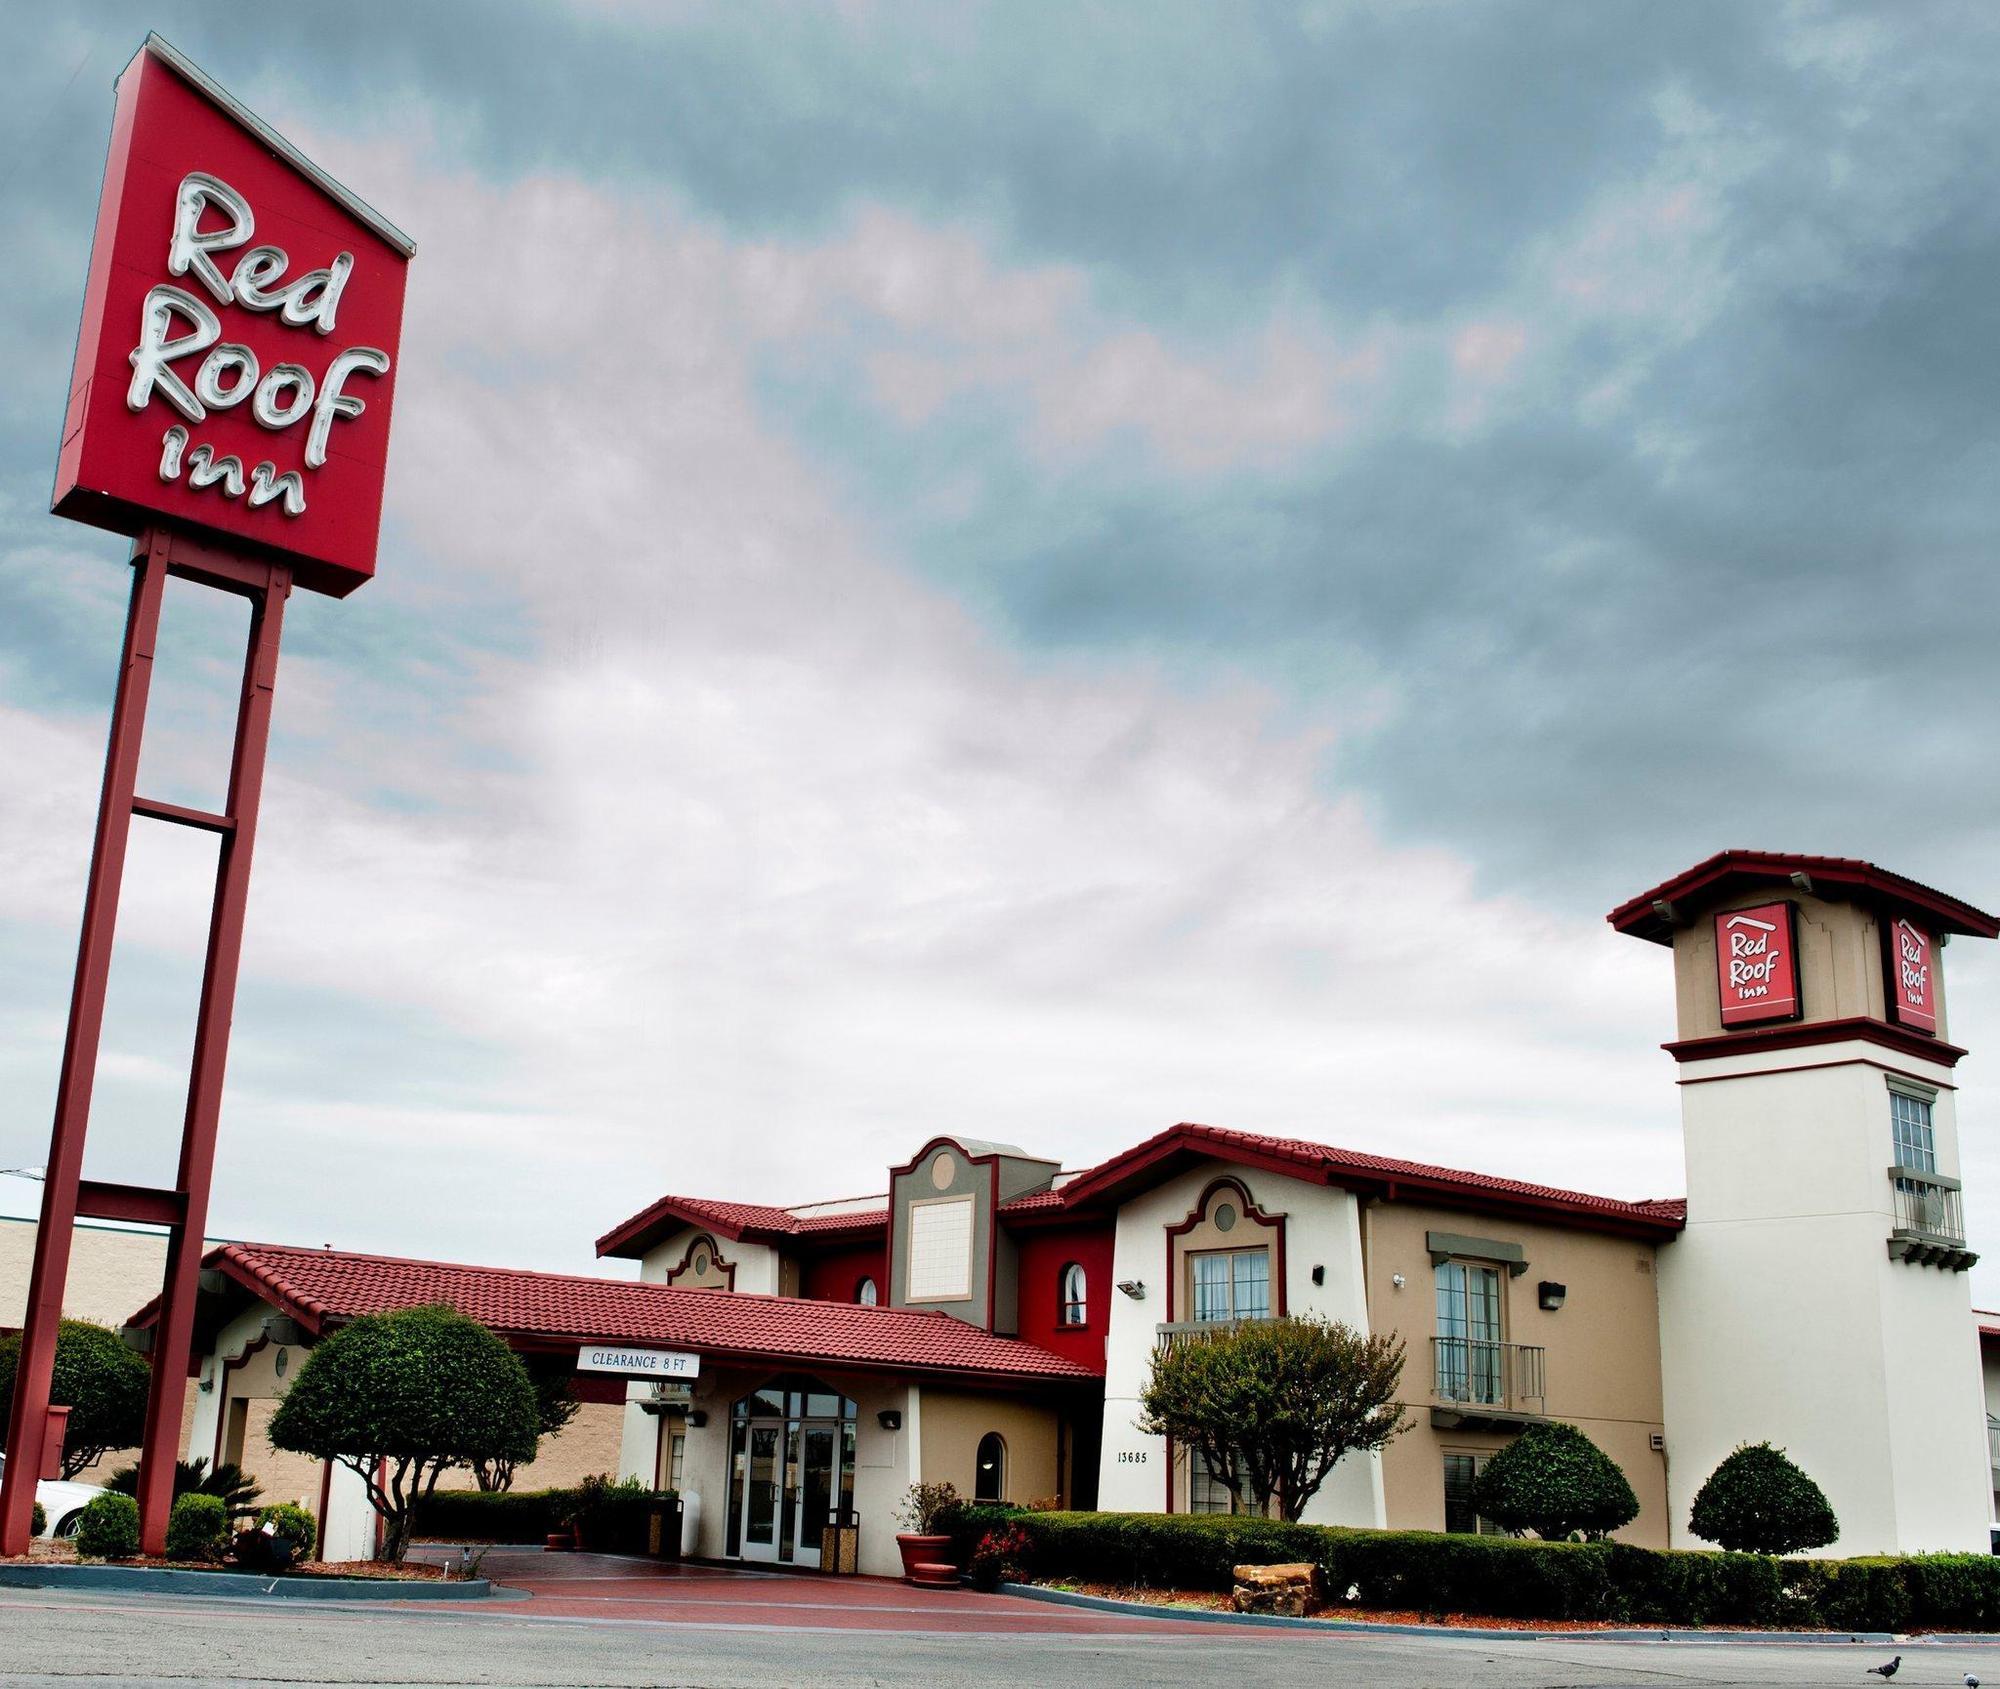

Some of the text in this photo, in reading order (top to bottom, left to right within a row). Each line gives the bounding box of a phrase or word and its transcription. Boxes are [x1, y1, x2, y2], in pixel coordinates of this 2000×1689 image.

[168, 171, 355, 336] Red
[127, 283, 391, 471] Roof
[1730, 932, 1768, 958] Red
[1901, 933, 1921, 965] Red
[1729, 950, 1780, 989] Roof
[1901, 960, 1928, 995] Roof
[592, 1352, 687, 1371] CLEARANCE 8 FT
[1118, 1451, 1147, 1464] 13685
